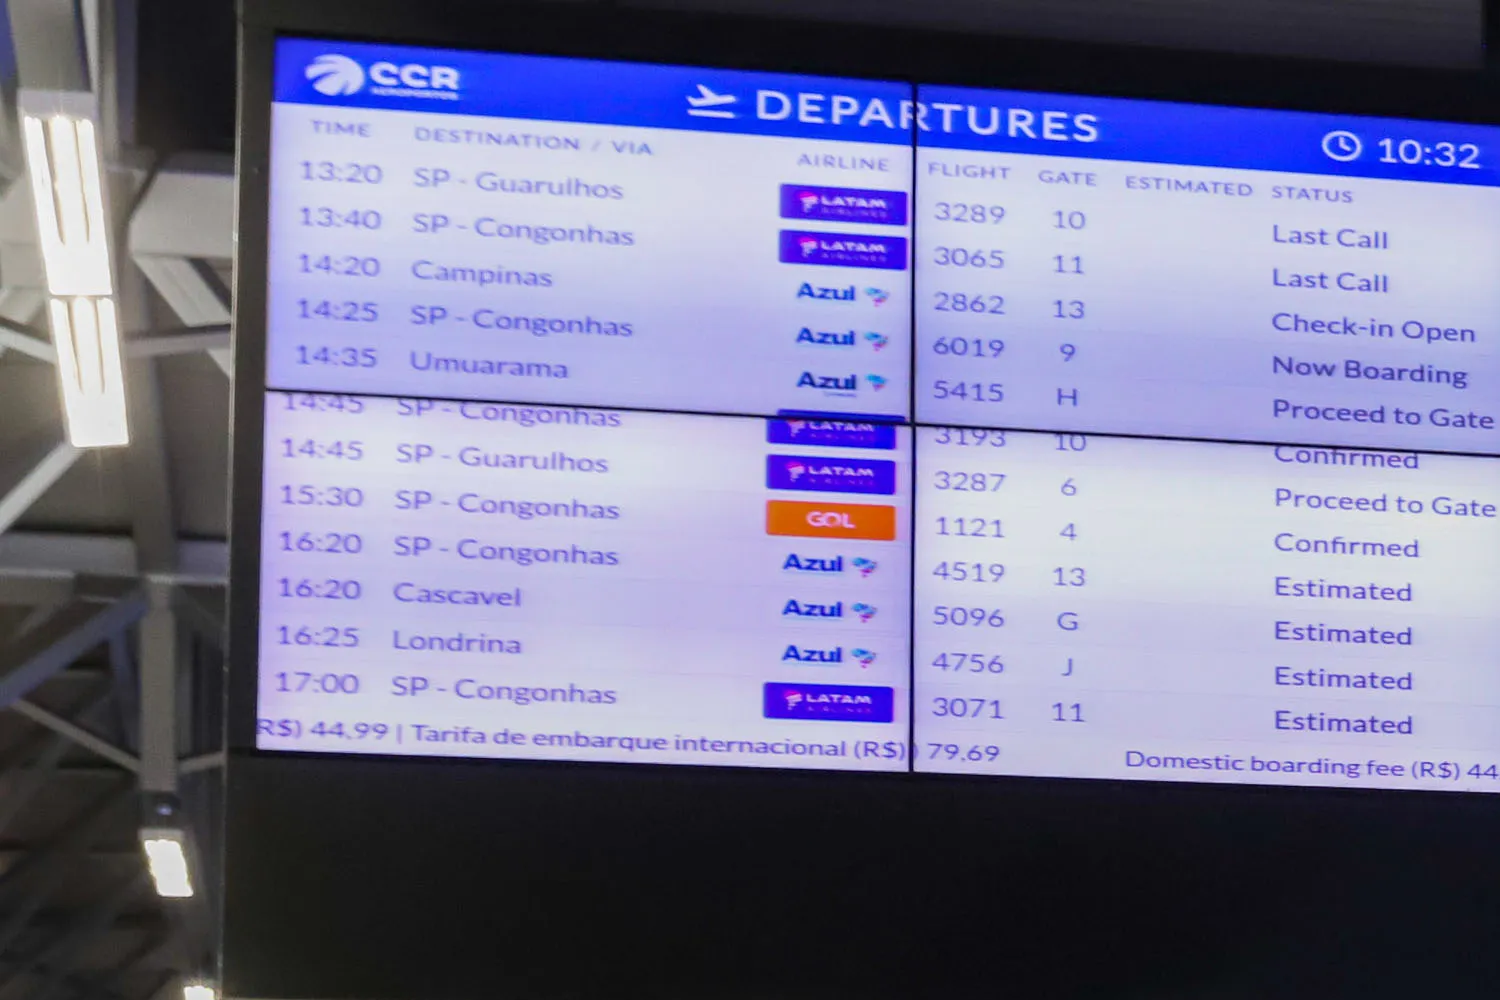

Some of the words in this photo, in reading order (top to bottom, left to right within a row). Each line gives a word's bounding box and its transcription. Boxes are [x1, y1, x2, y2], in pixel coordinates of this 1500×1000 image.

[370, 62, 460, 89] CCR
[757, 90, 1098, 142] DEPARTURES
[311, 120, 368, 137] TIME
[415, 127, 581, 150] DESTINATION
[612, 141, 652, 155] VIA
[798, 154, 889, 172] AIRLINE
[1379, 138, 1480, 169] 10:32
[299, 160, 383, 184] 13:20
[928, 162, 1010, 179] FLIGHT
[1038, 170, 1096, 186] GATE
[414, 168, 451, 187] SP
[475, 172, 623, 200] Guarulhos
[1126, 176, 1253, 196] ESTIMATED
[1272, 186, 1353, 203] STATUS
[300, 207, 382, 230] 13:40
[934, 202, 1005, 224] 3289
[1055, 210, 1086, 230] 10
[414, 214, 449, 233] SP
[474, 217, 635, 246] Congonhas
[1273, 225, 1329, 245] Last
[1337, 229, 1387, 249] Call
[299, 254, 380, 277] 14:20
[934, 246, 1004, 268] 3065
[1054, 255, 1084, 274] 11
[411, 260, 553, 287] Campinas
[1273, 269, 1328, 289] Last
[1336, 272, 1388, 293] Call
[797, 283, 855, 301] Azul
[934, 292, 1005, 314] 2862
[297, 299, 378, 322] 14:25
[1054, 300, 1084, 319] 13
[412, 306, 447, 325] SP
[472, 309, 633, 337] Congonhas
[1272, 313, 1394, 337] Check-in
[1402, 321, 1475, 344] Open
[797, 328, 855, 345] Azul
[932, 336, 1004, 358] 6019
[297, 345, 377, 368] 14:35
[410, 352, 568, 378] Umuarama
[797, 372, 856, 390] Azul
[1273, 356, 1336, 376] Now
[1344, 360, 1468, 389] Boarding
[934, 380, 1003, 402] 5415
[1274, 399, 1385, 423] Proceed
[1393, 408, 1421, 425] to
[1429, 408, 1494, 429] Gate
[280, 437, 362, 460] 14:45
[397, 444, 434, 463] SP
[458, 447, 608, 473] Guarulhos
[934, 471, 1006, 491] 3287
[280, 484, 364, 507] 15:30
[396, 490, 432, 509] SP
[457, 493, 620, 520] Congonhas
[1276, 488, 1387, 512] Proceed
[1395, 496, 1423, 513] to
[1432, 497, 1496, 517] Gate
[806, 512, 854, 528] GOL
[936, 516, 1004, 538] 1121
[1275, 533, 1419, 557] Confirmed
[278, 577, 361, 599] 16:20
[393, 582, 521, 606] Cascavel
[783, 600, 842, 617] Azul
[934, 606, 1004, 627] 5096
[276, 625, 359, 647] 16:25
[393, 630, 522, 654] Londrina
[1275, 621, 1412, 645] Estimated
[782, 645, 842, 663] Azul
[932, 653, 1004, 673] 4756
[274, 672, 359, 694] 17:00
[1275, 667, 1412, 690] Estimated
[392, 676, 429, 696] SP
[454, 679, 616, 705] Congonhas
[932, 697, 1004, 719] 3071
[1053, 703, 1084, 722] 11
[1276, 710, 1412, 734] Estimated
[412, 724, 487, 744] Tarifa
[493, 729, 526, 745] de
[532, 731, 669, 752] embarque
[675, 735, 847, 756] internacional
[1126, 751, 1244, 771] Domestic
[1251, 756, 1360, 778] boarding
[1366, 760, 1405, 776] fee
[1412, 761, 1460, 780] (R$)
